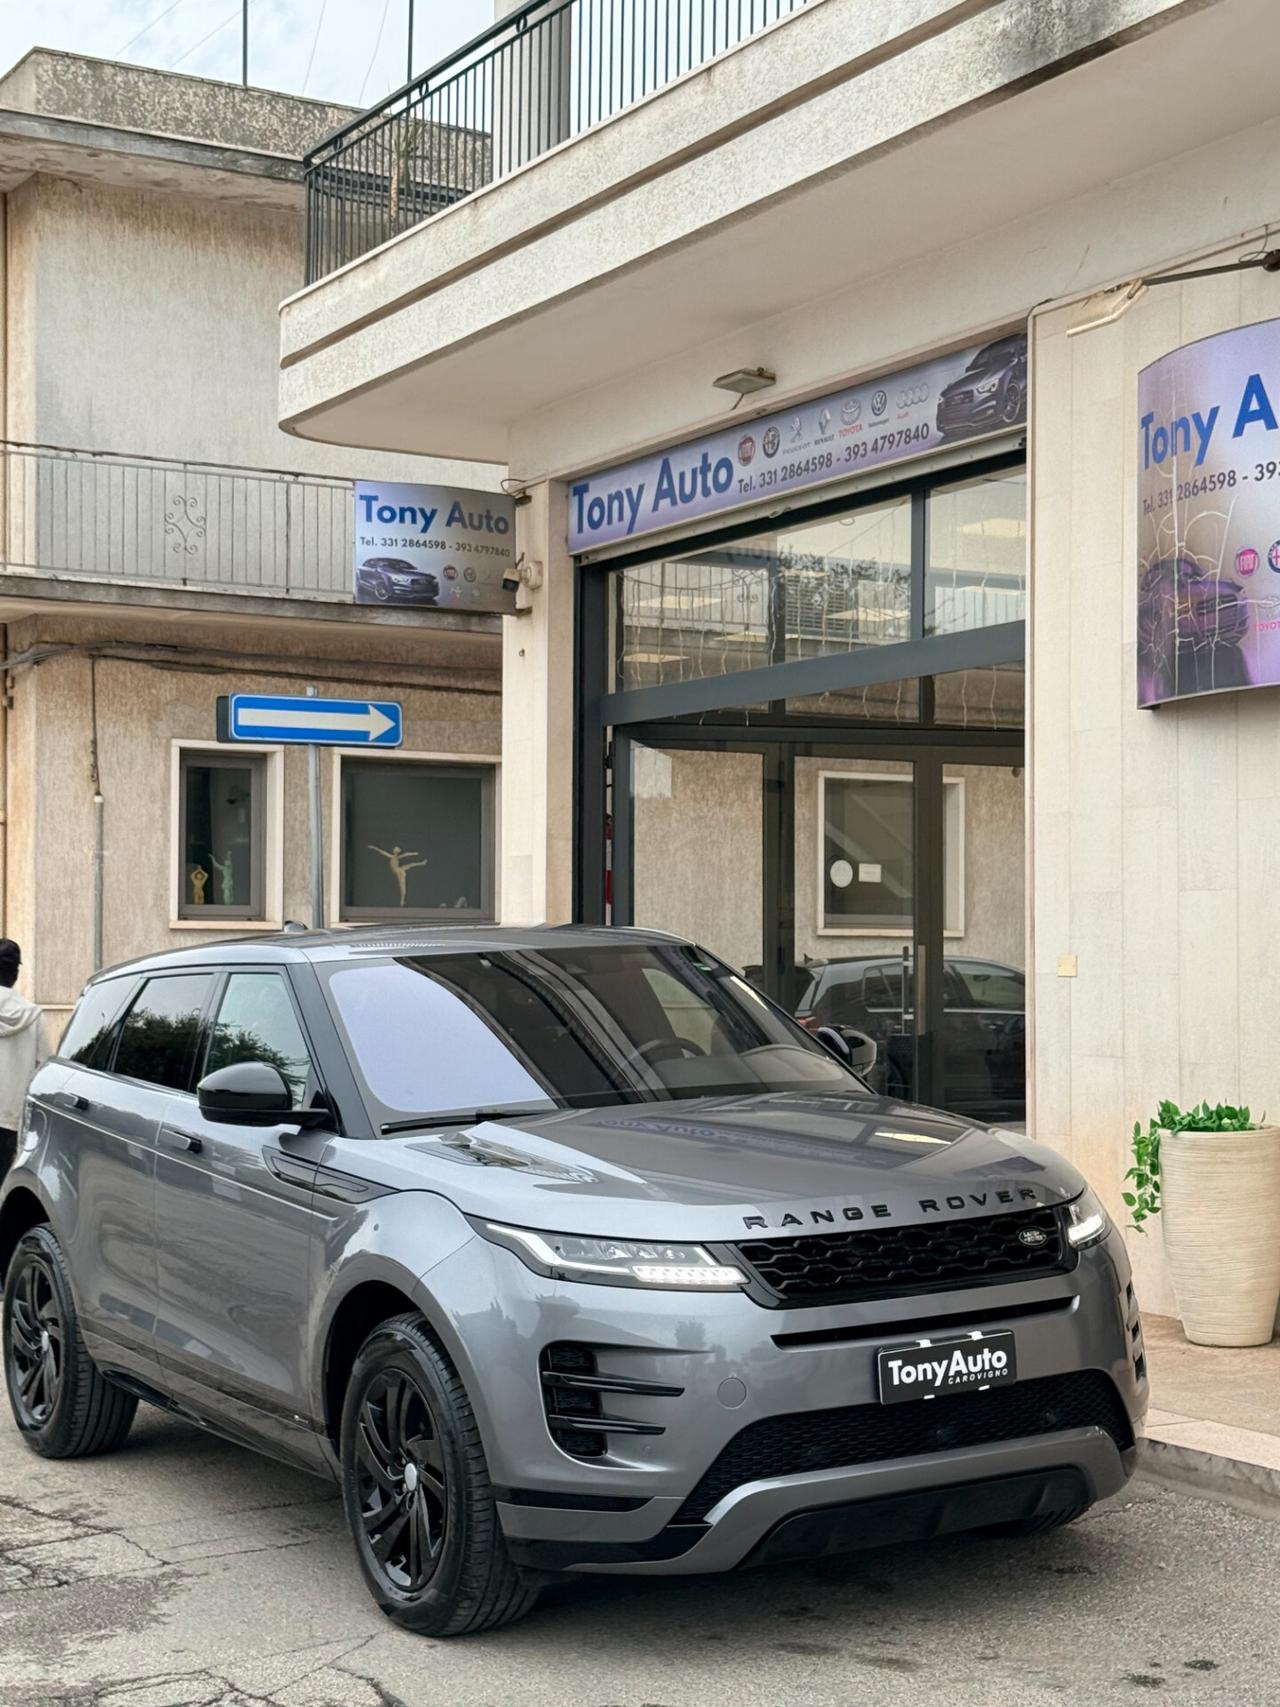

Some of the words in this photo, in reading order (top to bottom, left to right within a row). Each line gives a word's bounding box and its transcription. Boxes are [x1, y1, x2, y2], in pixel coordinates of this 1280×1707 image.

[838, 424, 863, 437] TOYOTA
[1141, 405, 1220, 470] Tony
[1232, 373, 1279, 439] A
[738, 475, 756, 494] Tel.
[760, 468, 777, 488] 331
[781, 452, 833, 481] 2864598
[844, 441, 868, 462] 393
[870, 422, 930, 454] 4797840
[573, 483, 645, 535] Tony
[651, 452, 734, 512] Auto
[1176, 469, 1237, 501] 2864598
[359, 494, 438, 534] Tony
[445, 501, 510, 535] Auto
[360, 536, 377, 547] Tel.
[381, 538, 398, 548] 331
[401, 538, 447, 550] 2864598
[742, 1204, 892, 1230] RANGE
[918, 1188, 1037, 1213] ROVER
[948, 1368, 1008, 1384] CAROVIGNO
